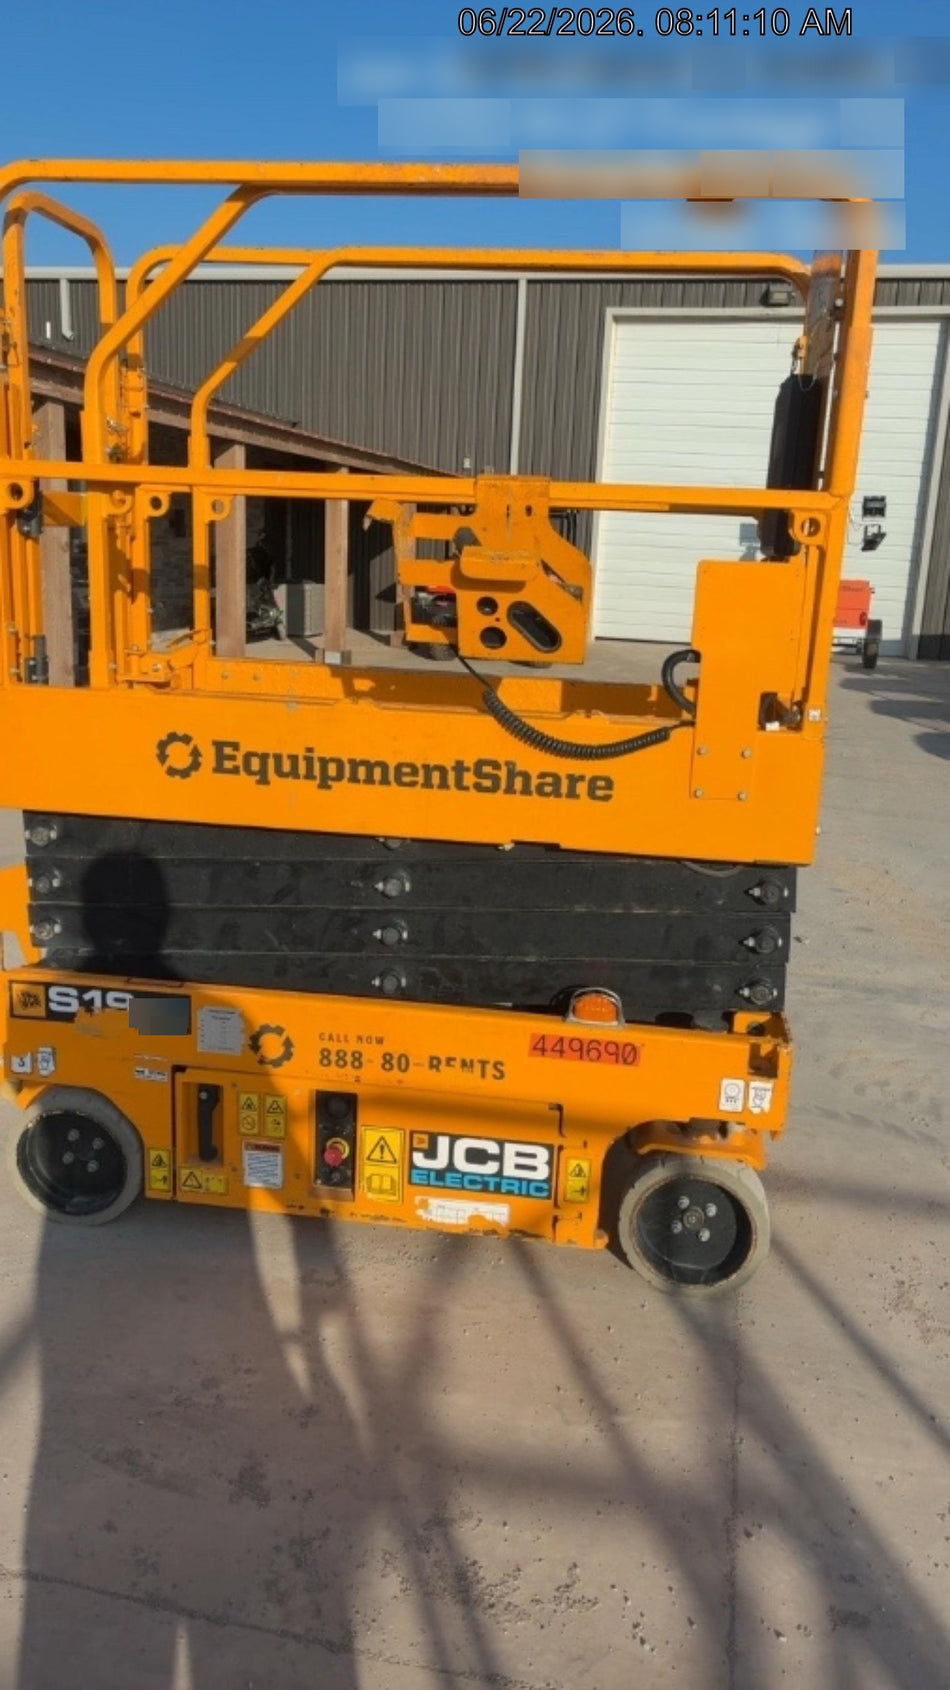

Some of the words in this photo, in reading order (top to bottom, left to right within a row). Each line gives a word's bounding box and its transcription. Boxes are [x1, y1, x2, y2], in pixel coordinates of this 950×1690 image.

[211, 739, 615, 802] EquipmentShare
[318, 1032, 349, 1043] CALL
[356, 1035, 385, 1045] NOW
[532, 1034, 637, 1065] 449690
[412, 1135, 551, 1181] JCB
[410, 1169, 550, 1198] ELECTRIC
